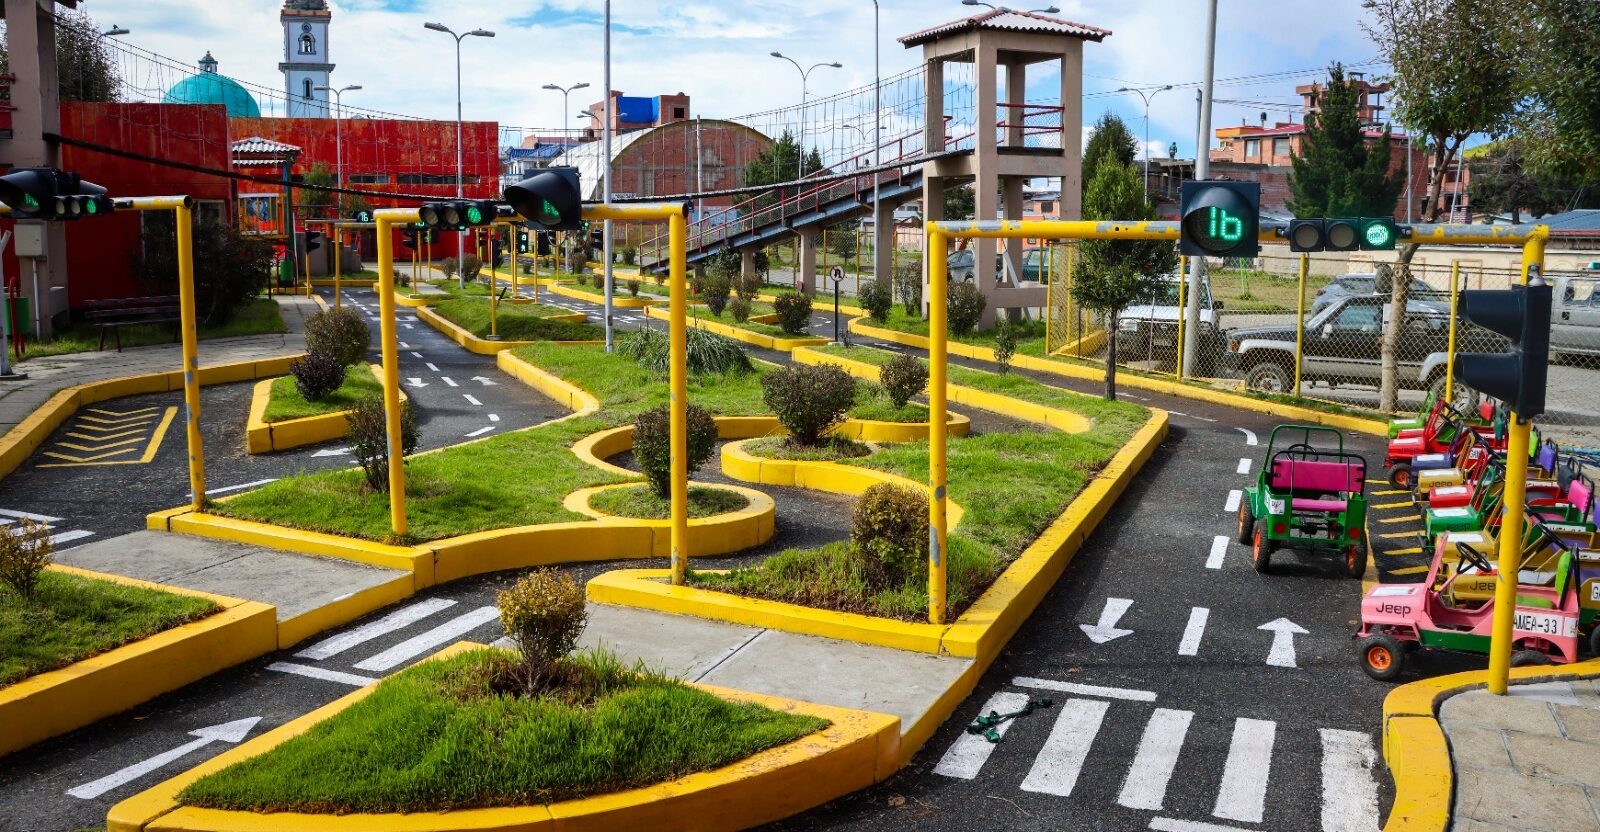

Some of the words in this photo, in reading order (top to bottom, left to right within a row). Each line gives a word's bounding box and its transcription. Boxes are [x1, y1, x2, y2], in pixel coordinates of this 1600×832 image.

[1470, 581, 1496, 591] Jee
[1376, 602, 1411, 618] Jeep
[1513, 614, 1557, 634] AMEA-33
